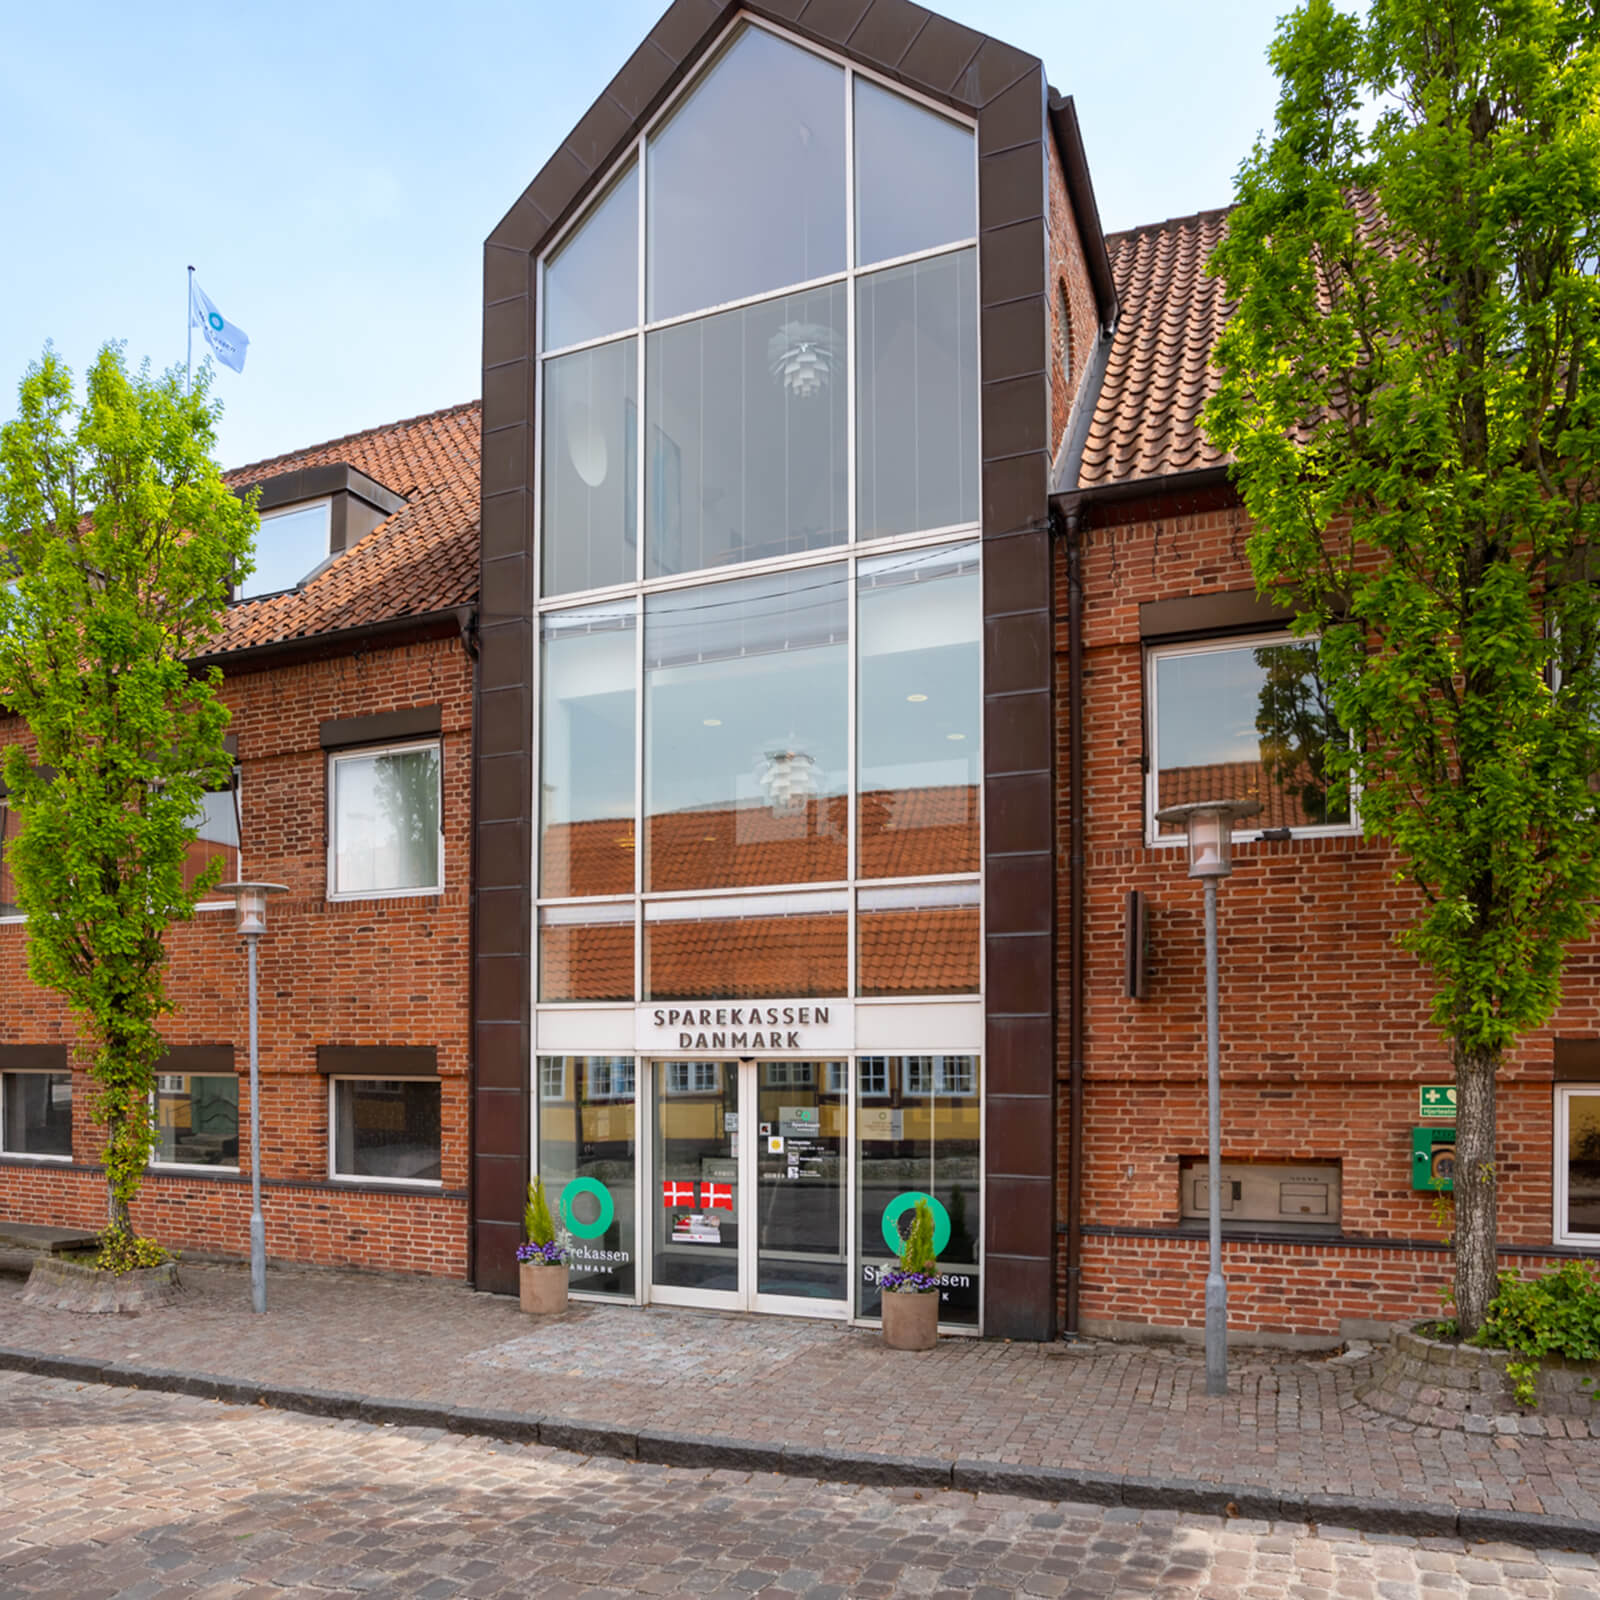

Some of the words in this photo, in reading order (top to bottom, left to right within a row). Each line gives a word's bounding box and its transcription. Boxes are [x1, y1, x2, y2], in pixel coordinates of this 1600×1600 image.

[653, 1007, 830, 1026] SPAREKASSEN
[679, 1031, 801, 1048] DANMARK
[570, 1245, 629, 1262] rekassen
[570, 1264, 614, 1274] ANMARK
